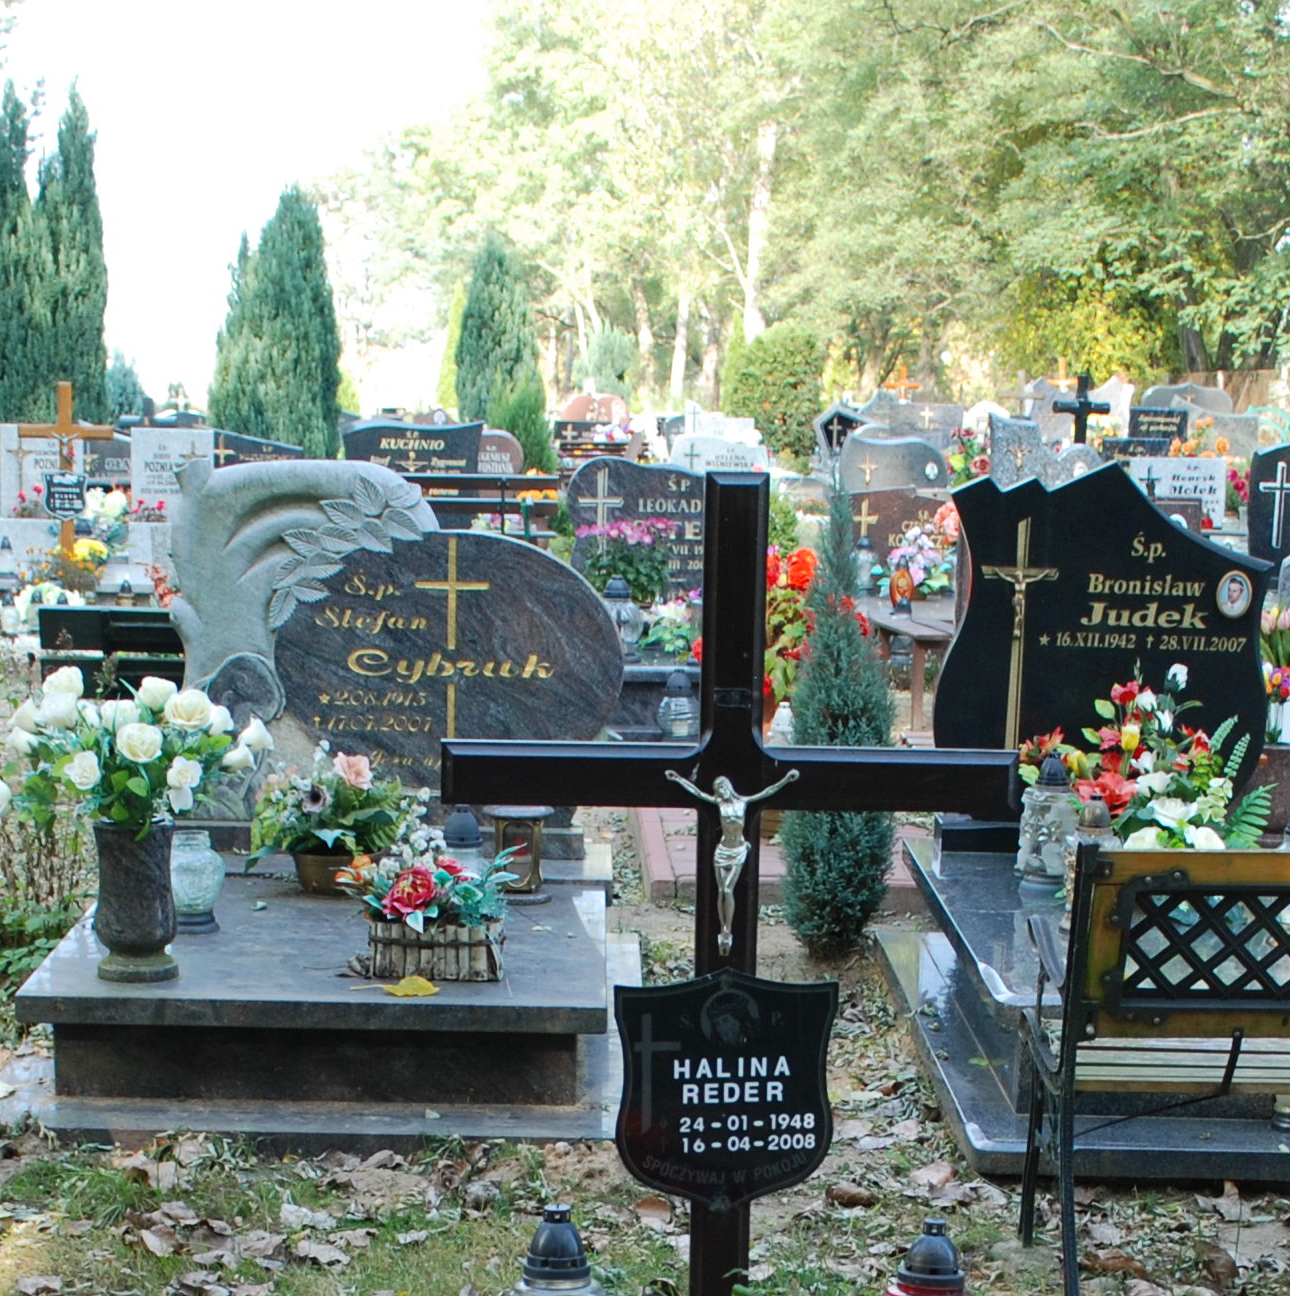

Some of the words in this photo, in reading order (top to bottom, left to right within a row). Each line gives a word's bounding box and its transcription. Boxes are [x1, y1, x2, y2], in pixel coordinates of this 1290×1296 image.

[380, 438, 446, 451] KUCHNIO
[1087, 573, 1206, 598] Bronisław
[314, 605, 429, 635] Stefan
[1080, 601, 1210, 630] Judek
[1056, 631, 1138, 650] 16.XII.1942
[1159, 634, 1248, 653] 28.VII.2007
[347, 648, 556, 684] Cybruk
[673, 1055, 791, 1080] HALINA
[682, 1081, 785, 1105] REDER
[732, 1169, 746, 1184] W
